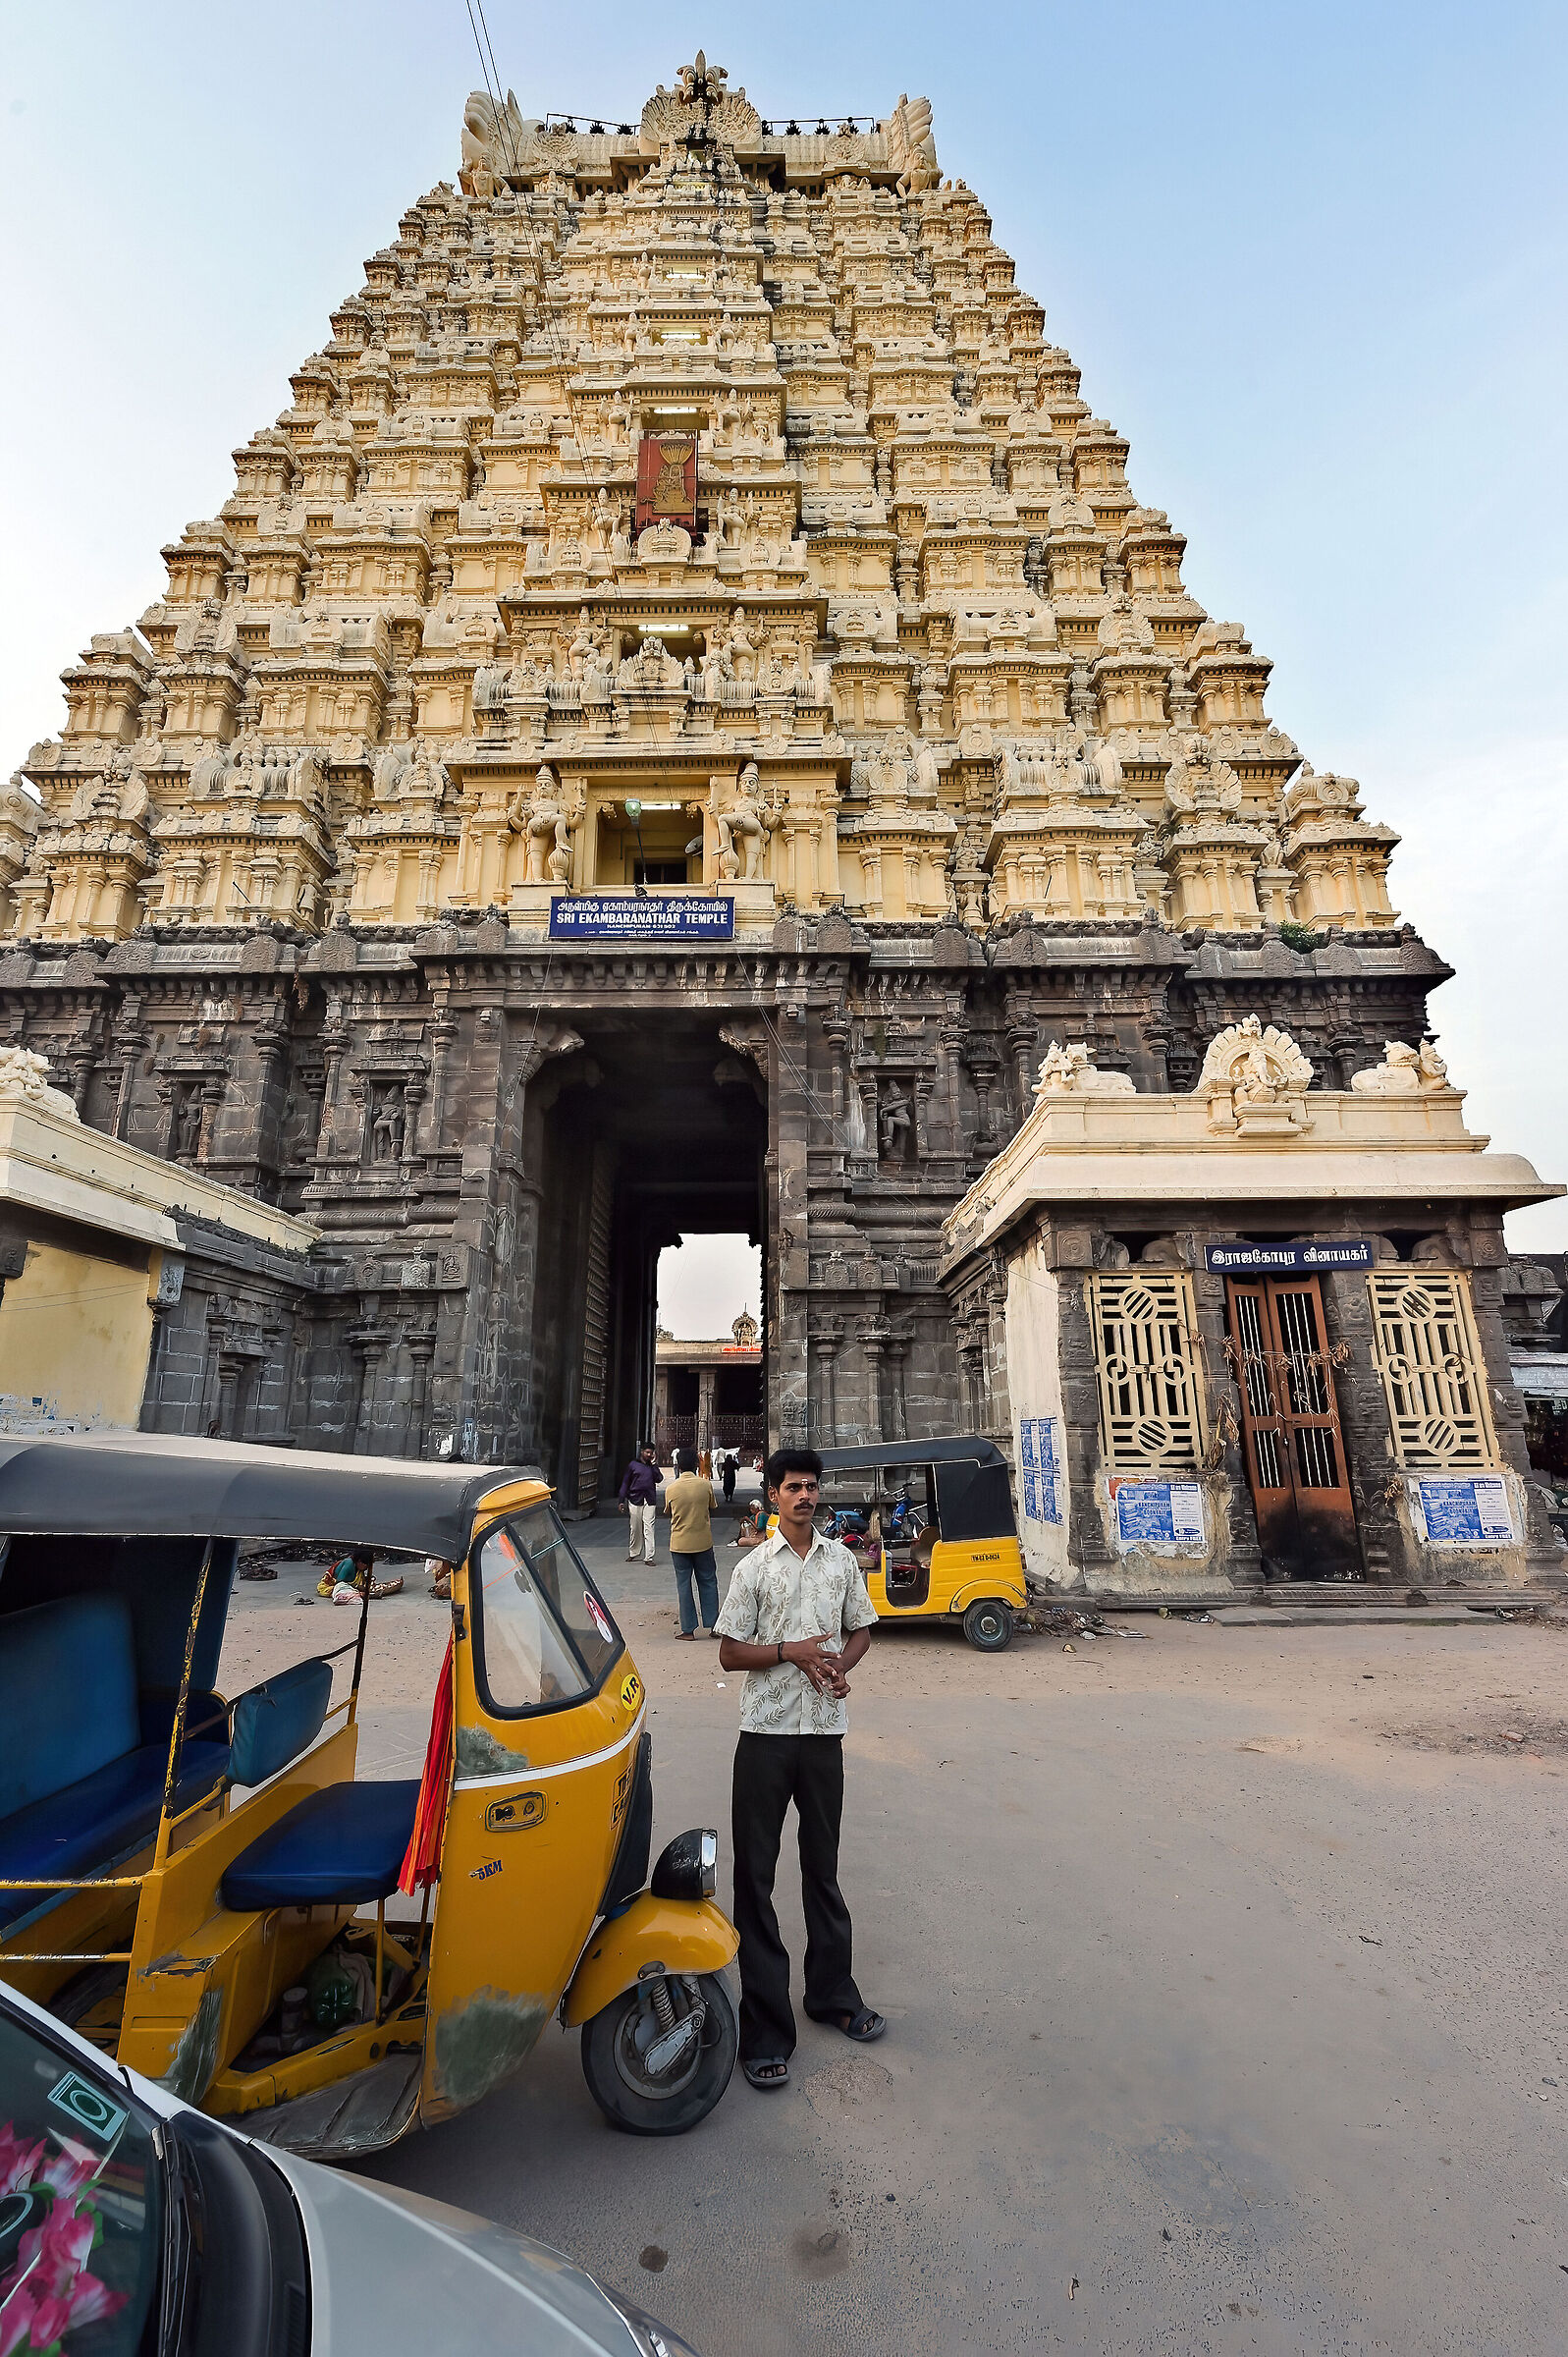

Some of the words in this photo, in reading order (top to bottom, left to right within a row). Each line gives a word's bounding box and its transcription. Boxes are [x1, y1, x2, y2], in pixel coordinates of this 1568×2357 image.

[557, 901, 599, 912] அருள்மிகு
[602, 901, 663, 912] ஏகாம்பரநாதர்
[666, 901, 728, 912] திருக்கோயில்
[557, 912, 575, 924] SRI
[578, 912, 680, 924] EKAMBARANATHAR
[684, 912, 728, 924] TEMPLE
[1211, 1248, 1296, 1266] இராஜகோபுர
